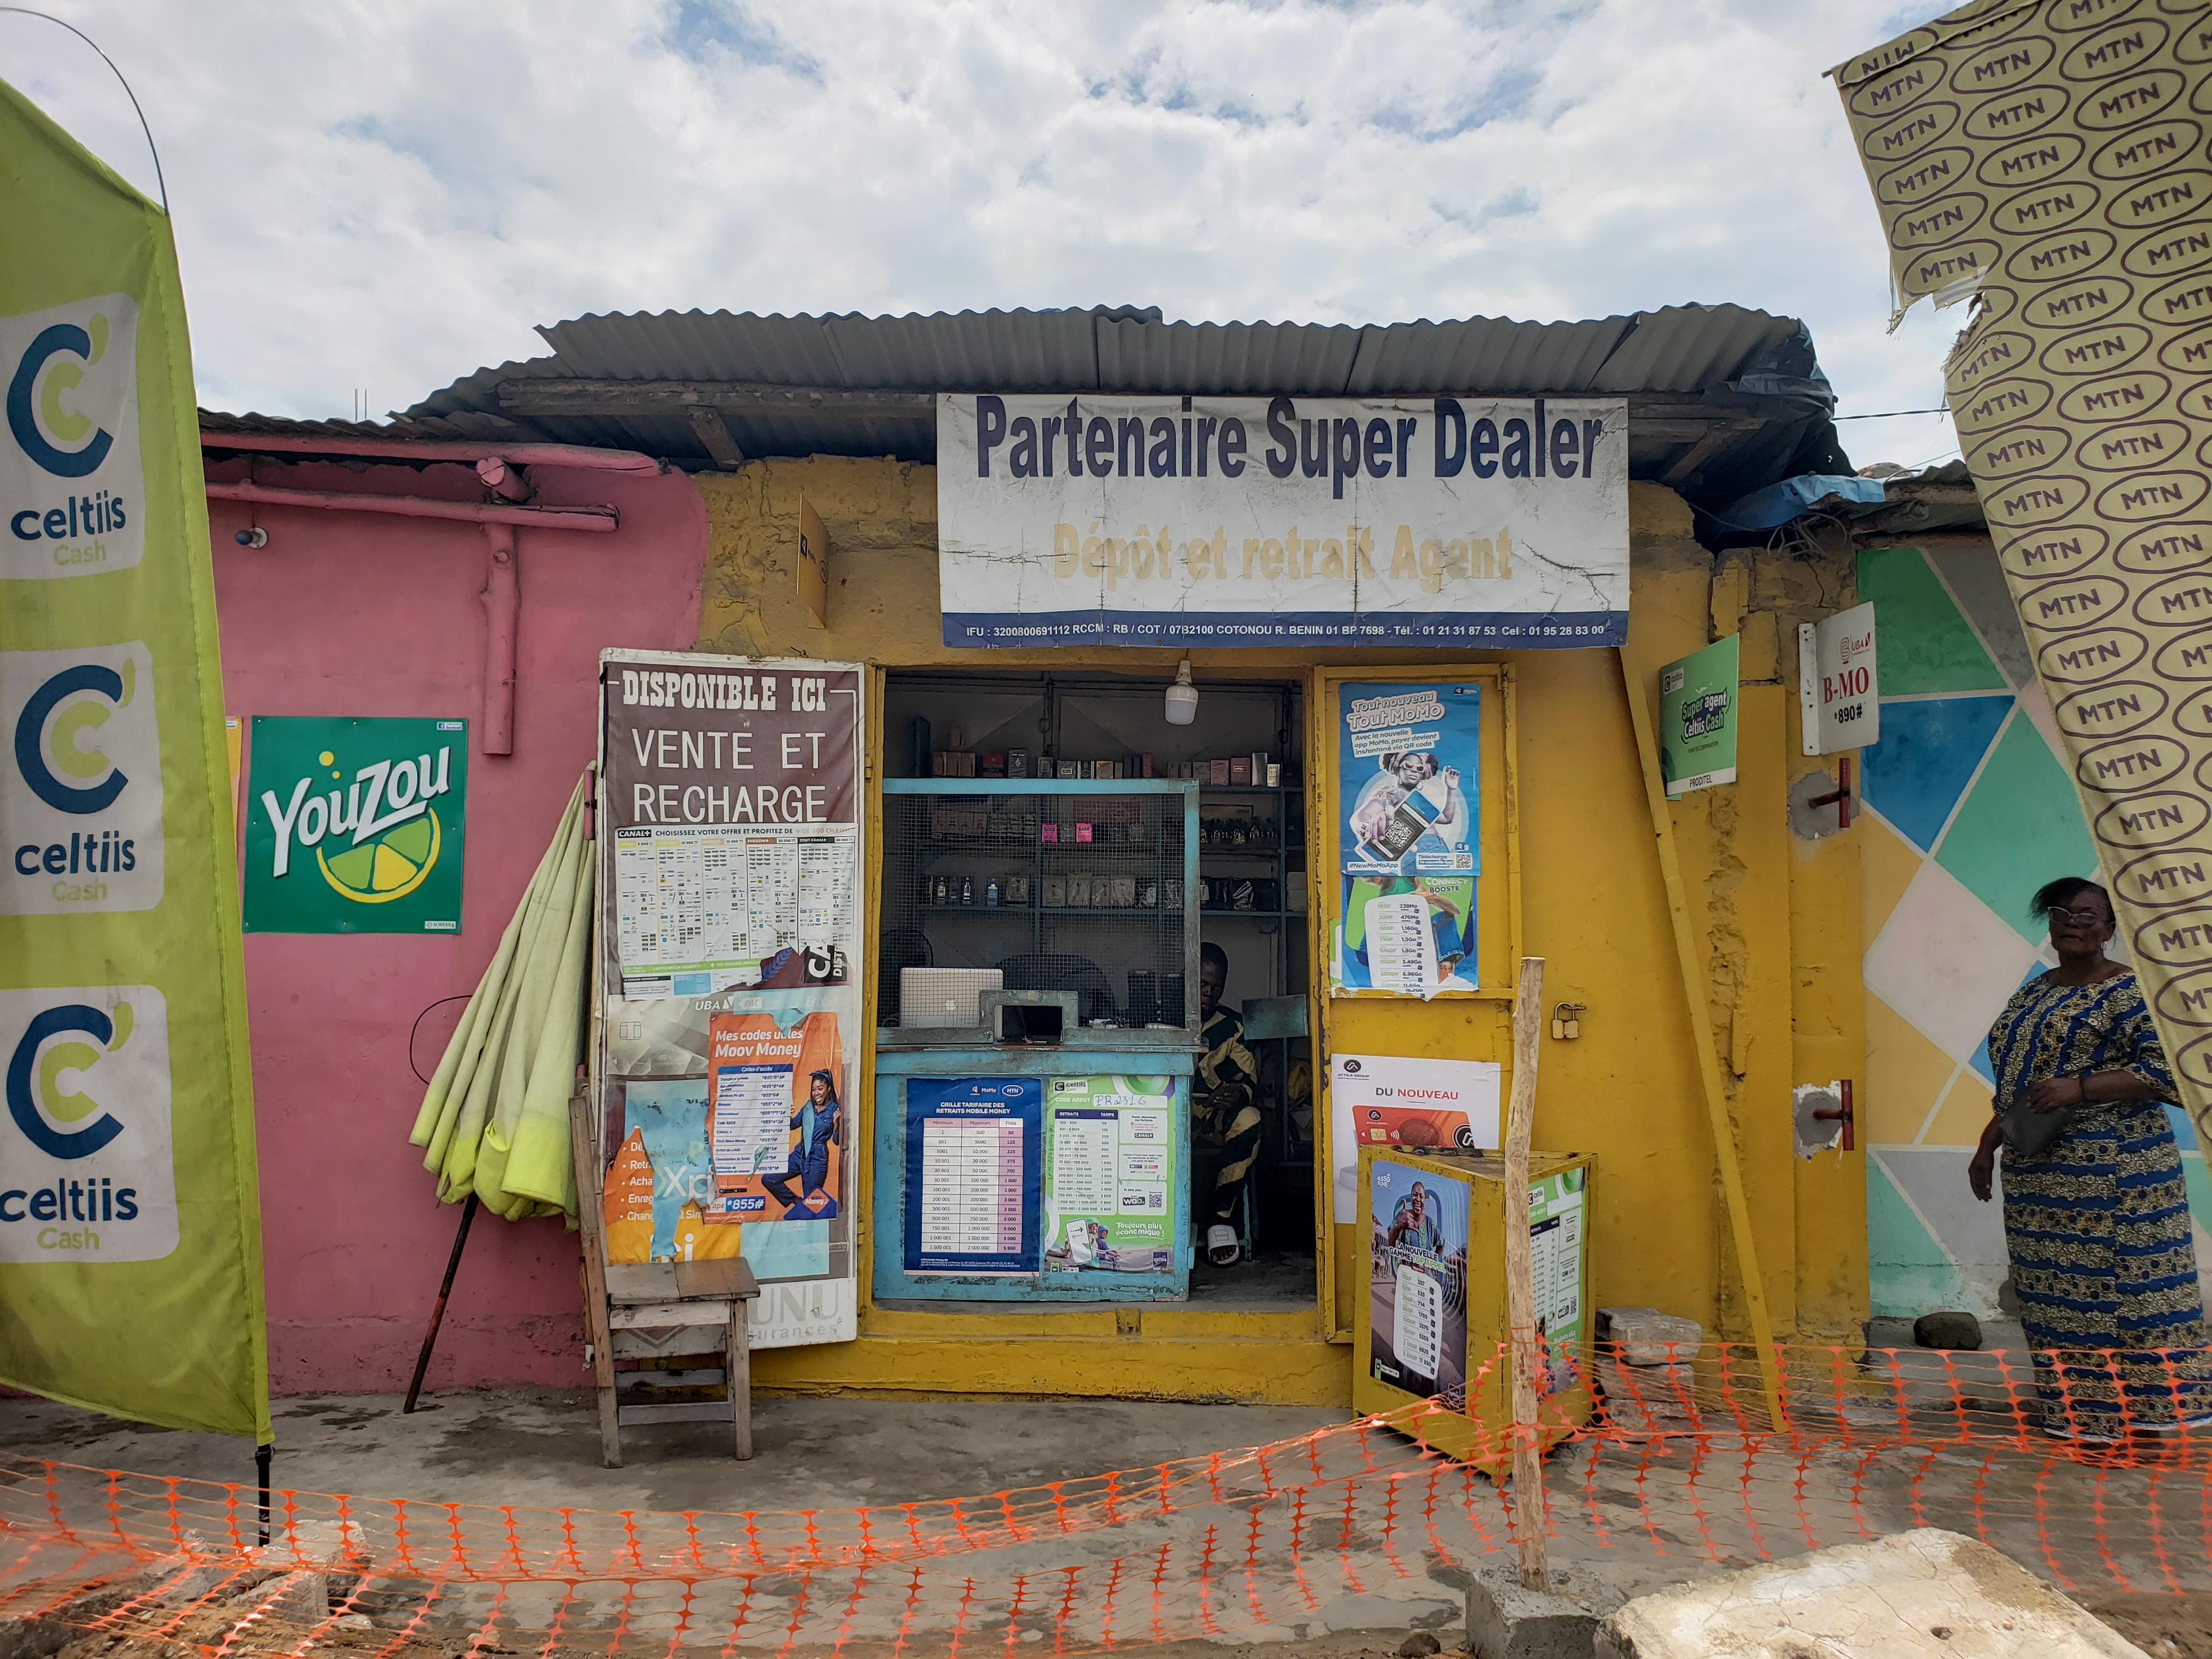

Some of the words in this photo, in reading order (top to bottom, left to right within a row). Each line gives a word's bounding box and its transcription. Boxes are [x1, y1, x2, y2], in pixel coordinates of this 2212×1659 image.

[2084, 32, 2144, 67] MTN
[1870, 70, 1923, 106] MTN
[1988, 98, 2045, 128] MTN
[2115, 132, 2176, 168] MTN
[1894, 160, 1949, 194] MTN
[2016, 194, 2075, 224] MTN
[1920, 252, 1977, 283] MTN
[1961, 342, 2011, 382] MTN
[2083, 383, 2144, 411] MTN
[977, 396, 1248, 478] Partenaire
[1266, 395, 1417, 499] Super
[1434, 398, 1602, 479] Dealer
[1987, 439, 2046, 468] MTN
[2121, 483, 2182, 510] MTN
[11, 491, 126, 541] celtiis
[53, 541, 106, 567] Cash
[1054, 522, 1172, 592] Dépôt
[1187, 525, 1227, 580] et
[1243, 525, 1374, 580] retrait
[1389, 524, 1513, 594] Agent
[2022, 537, 2081, 566] MTN
[2039, 588, 2101, 619] MTN
[967, 628, 984, 636] IFU
[994, 625, 1070, 636] 3200800691112
[1073, 624, 1104, 634] RCCM
[1113, 624, 1128, 633] RB
[1138, 625, 1160, 634] COT
[1217, 625, 1272, 634] COTONOU
[1290, 626, 1323, 634] BENIN
[1326, 626, 1337, 635] 01
[1342, 626, 1357, 635] BP
[1360, 626, 1384, 635] 7698
[1423, 626, 1435, 635] 01
[1438, 626, 1449, 635] 21
[1453, 626, 1465, 635] 31
[1468, 626, 1481, 635] 87
[1483, 626, 1496, 635] 53
[1502, 626, 1519, 635] Cel
[1528, 626, 1540, 635] 01
[1543, 626, 1556, 635] 95
[1559, 626, 1572, 635] 28
[1575, 626, 1588, 635] 83
[1591, 625, 1604, 635] 00
[1852, 640, 1864, 651] UBA
[622, 670, 776, 710] DISPONIBLE
[792, 678, 826, 711] ICI
[1823, 667, 1869, 703] B-MO
[1349, 712, 1388, 729] Tout
[1390, 704, 1441, 723] MoMo
[1354, 699, 1381, 712] Tout
[1383, 693, 1434, 708] nouveau
[1683, 698, 1704, 720] Super
[1705, 691, 1727, 712] agent
[2077, 693, 2141, 724] MTN
[1380, 730, 1408, 738] nouvelle
[1684, 717, 1705, 738] Celtiis
[1706, 710, 1724, 731] Cash
[631, 729, 754, 769] VENTE
[781, 733, 826, 769] ET
[1355, 746, 1391, 755] instantané
[1689, 775, 1712, 788] PRODITEL
[634, 784, 827, 822] RECHARGE
[15, 831, 136, 876] celtiis
[52, 880, 108, 902] Cash
[1425, 877, 1469, 885] CONNECT
[2138, 862, 2205, 893] MTN
[695, 1001, 720, 1011] UBA
[715, 1044, 754, 1057] Moov
[756, 1042, 802, 1058] Money
[716, 1031, 737, 1041] Mes
[741, 1031, 771, 1041] codes
[1397, 1089, 1458, 1100] NOUVEAU
[0, 1178, 138, 1222] celtiis
[37, 1228, 99, 1250] Cash
[1396, 1242, 1404, 1250] LA
[1406, 1245, 1438, 1261] NOUVELLE
[1389, 1248, 1411, 1260] GAMME
[1412, 1255, 1424, 1266] TOP
[1425, 1260, 1446, 1272] APPEL
